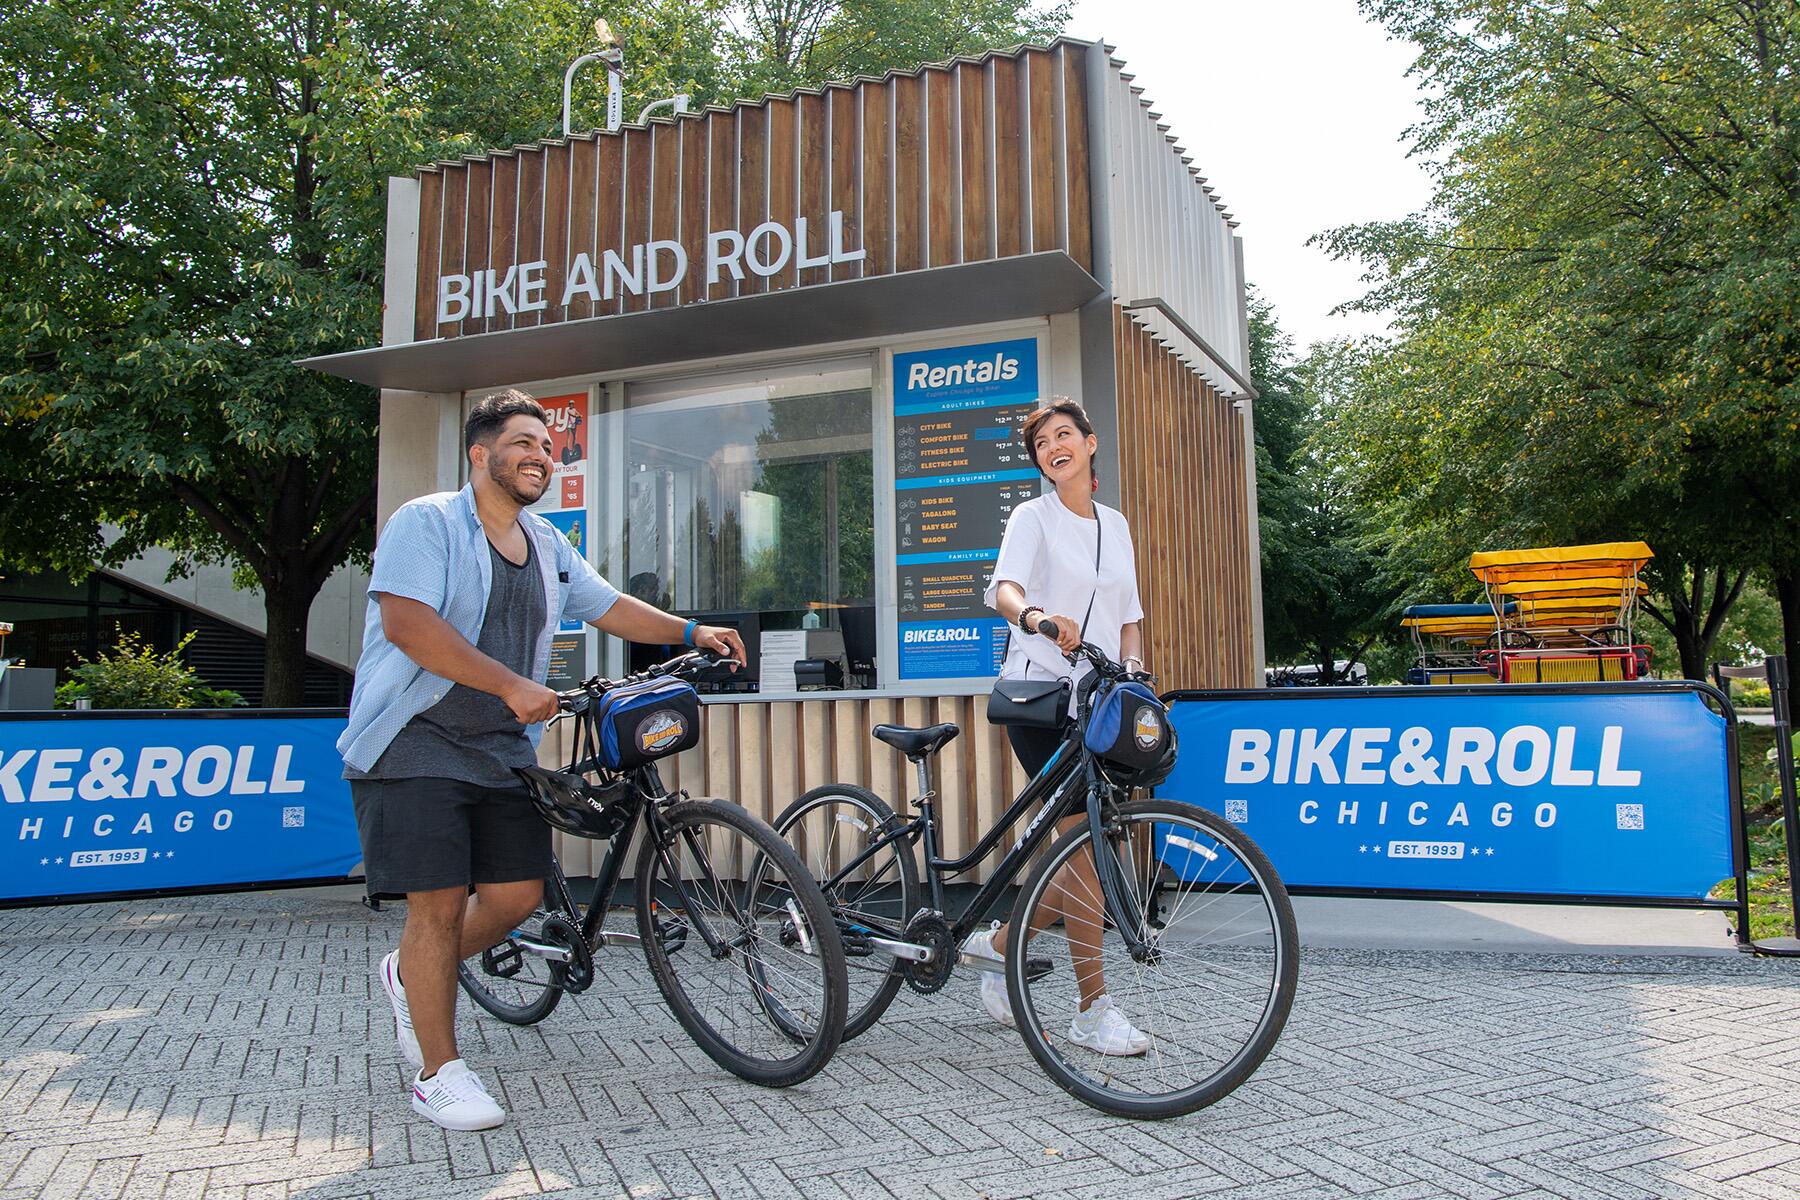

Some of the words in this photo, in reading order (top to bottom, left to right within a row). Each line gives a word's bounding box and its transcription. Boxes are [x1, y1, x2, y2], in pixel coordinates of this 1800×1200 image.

[438, 260, 548, 324] BIKE
[560, 240, 688, 306] AND
[708, 210, 867, 285] ROLL
[908, 353, 1019, 390] Rentals
[936, 422, 952, 430] BIKE
[920, 435, 952, 444] COMFORT
[920, 448, 948, 457] FITNESS
[949, 446, 965, 454] BIKE
[920, 460, 952, 470] ELECTRIC
[957, 474, 996, 482] EQUIPMENT
[921, 510, 957, 518] TAGALONG
[922, 523, 940, 531] BABY
[941, 522, 957, 530] SEAT
[922, 536, 947, 544] WAGON
[948, 552, 973, 560] FAMILY
[941, 574, 973, 582] QUADCYCLE
[904, 627, 980, 643] BIKE&ROLL
[1224, 726, 1641, 787] BIKE&ROLL
[0, 745, 305, 803] KE&ROLL
[1013, 784, 1064, 850] TREK
[1299, 800, 1557, 829] CHICAGO
[19, 809, 233, 841] HICAGO
[1394, 844, 1422, 856] EST.
[1425, 845, 1458, 857] 1993
[77, 853, 104, 864] EST.
[109, 851, 140, 862] 1993
